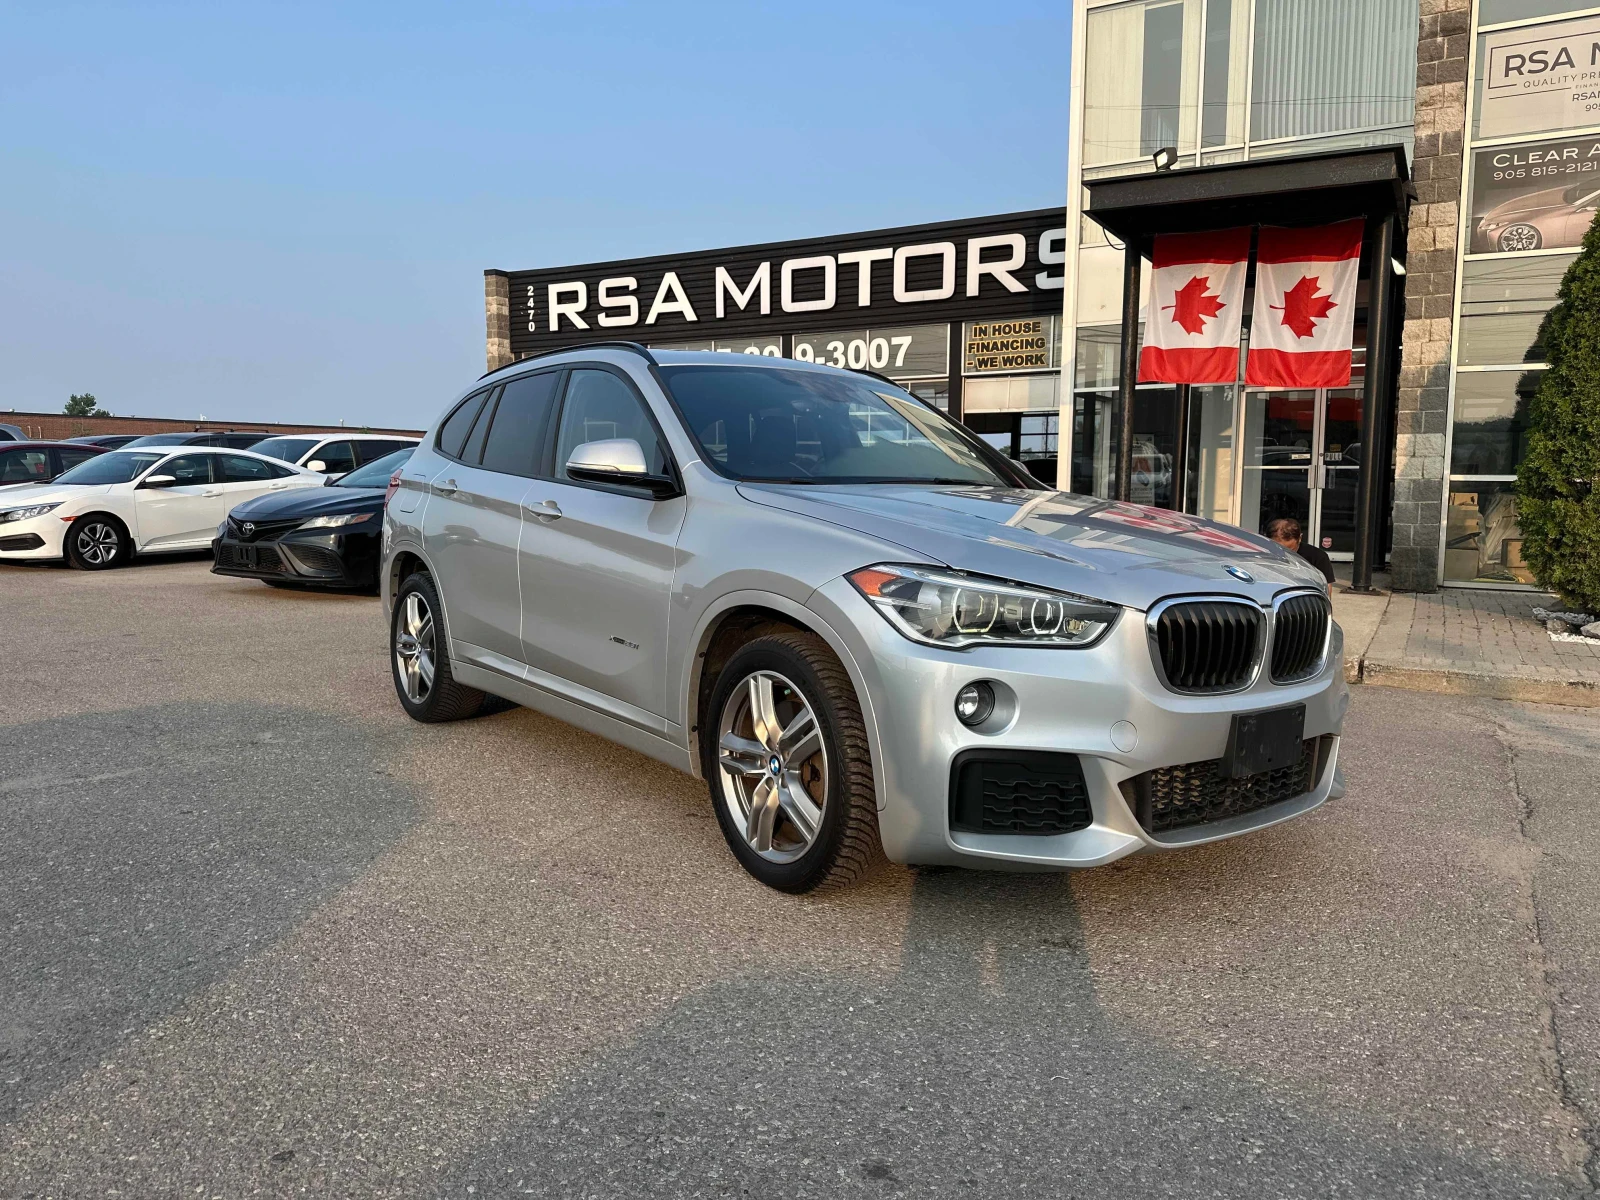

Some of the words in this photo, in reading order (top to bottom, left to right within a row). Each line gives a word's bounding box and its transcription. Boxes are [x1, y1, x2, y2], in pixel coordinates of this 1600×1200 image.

[1504, 47, 1576, 78] RSA
[1523, 74, 1578, 88] QUALITY
[1581, 71, 1600, 81] PR
[1493, 147, 1579, 168] CLEAR
[1493, 169, 1526, 181] 905
[1531, 161, 1598, 177] 815-2121
[527, 285, 536, 332] 2470
[548, 271, 699, 332] RSA
[972, 325, 989, 339] IN
[991, 321, 1042, 337] HOUSE
[966, 337, 1046, 354] FINANCING
[976, 356, 999, 370] WE
[1001, 353, 1047, 368] WORK
